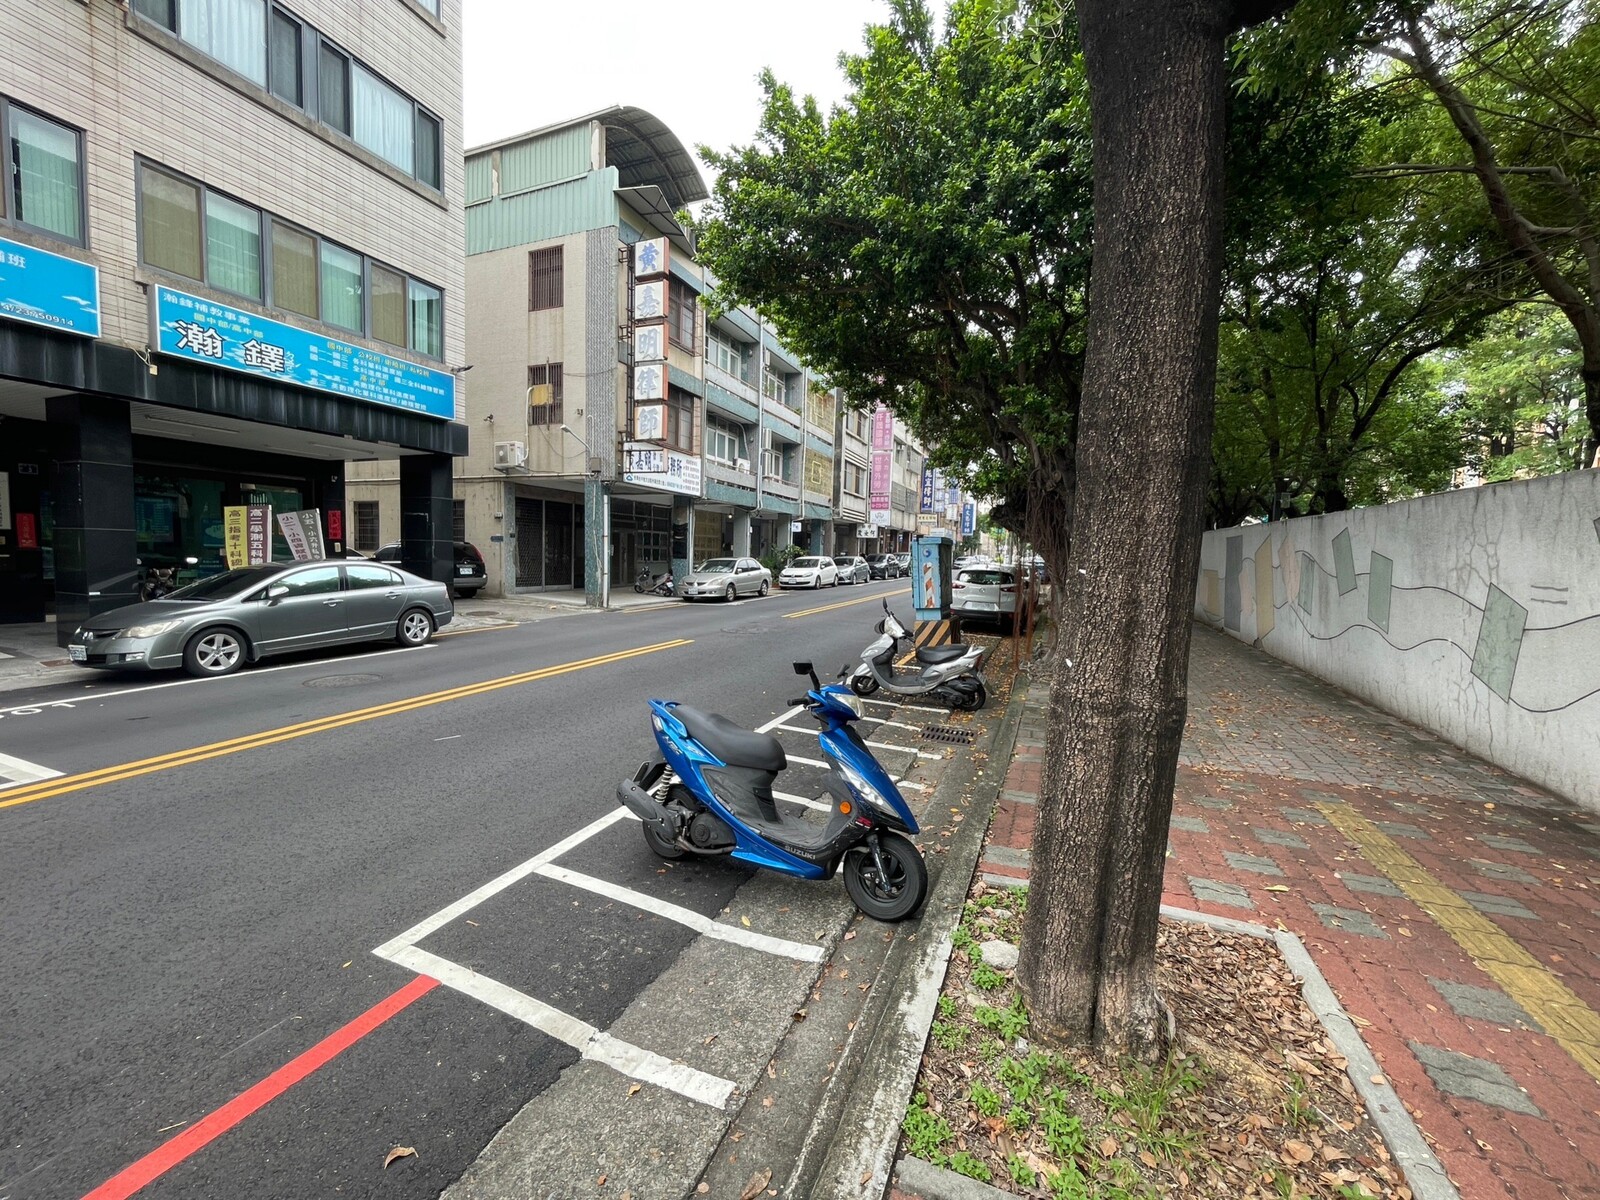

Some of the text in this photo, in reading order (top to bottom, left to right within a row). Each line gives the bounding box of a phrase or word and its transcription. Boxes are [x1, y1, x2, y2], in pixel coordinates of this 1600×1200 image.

[637, 242, 660, 437] 黃嘉明律師
[784, 845, 816, 860] SUZUKI
